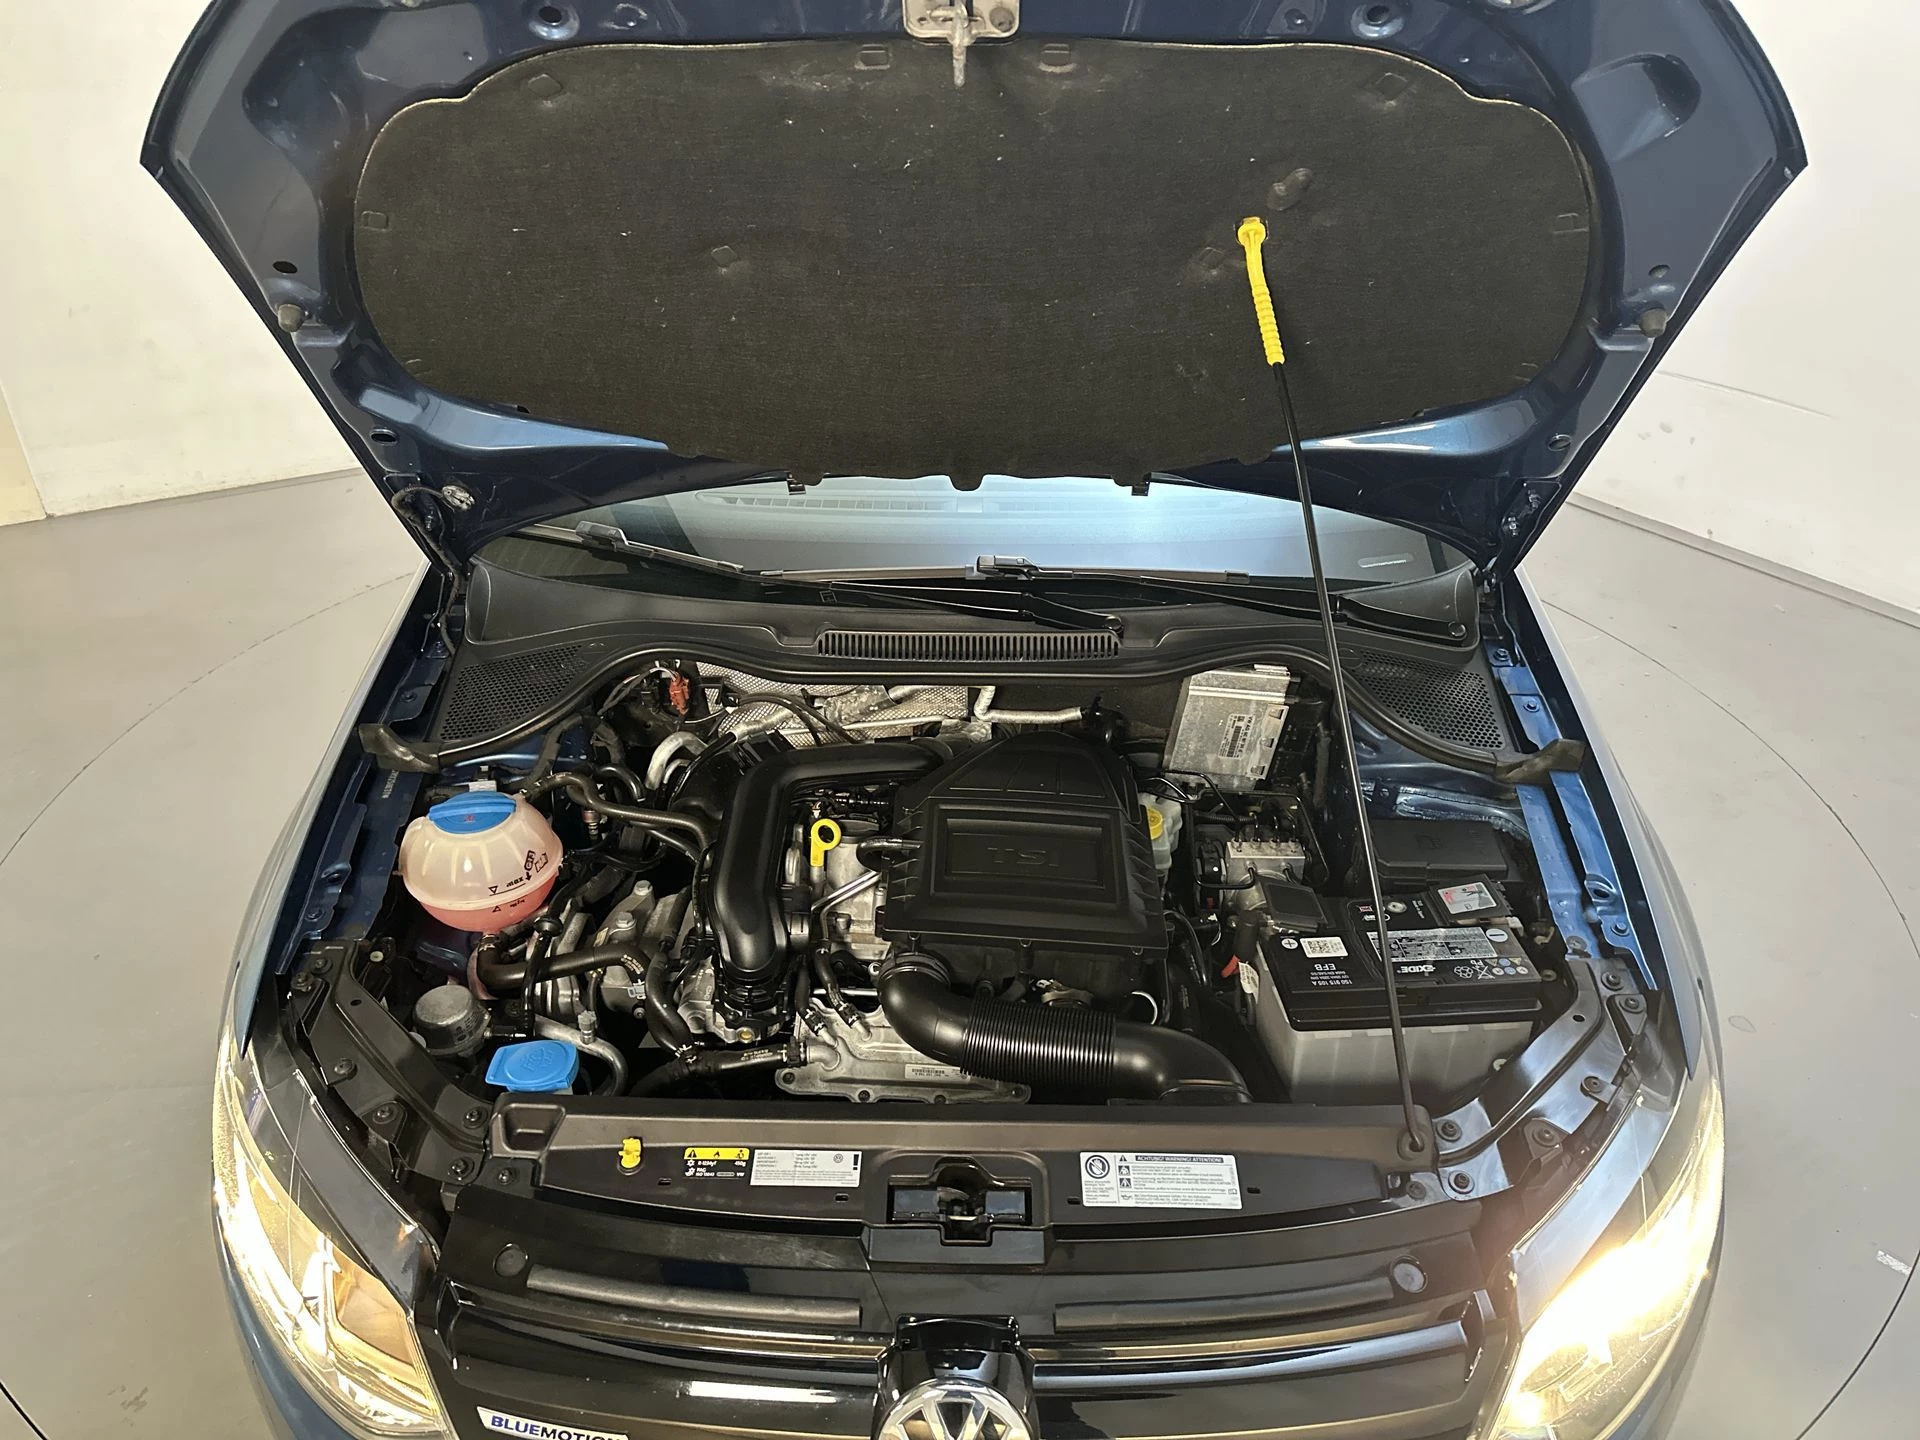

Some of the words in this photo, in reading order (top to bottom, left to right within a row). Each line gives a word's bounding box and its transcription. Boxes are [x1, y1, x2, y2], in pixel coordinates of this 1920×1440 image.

[506, 876, 524, 887] max
[1314, 963, 1337, 971] EFB
[1470, 959, 1485, 967] Pb
[1400, 964, 1436, 974] EXIDE
[491, 1415, 620, 1440] BLUEMOT
